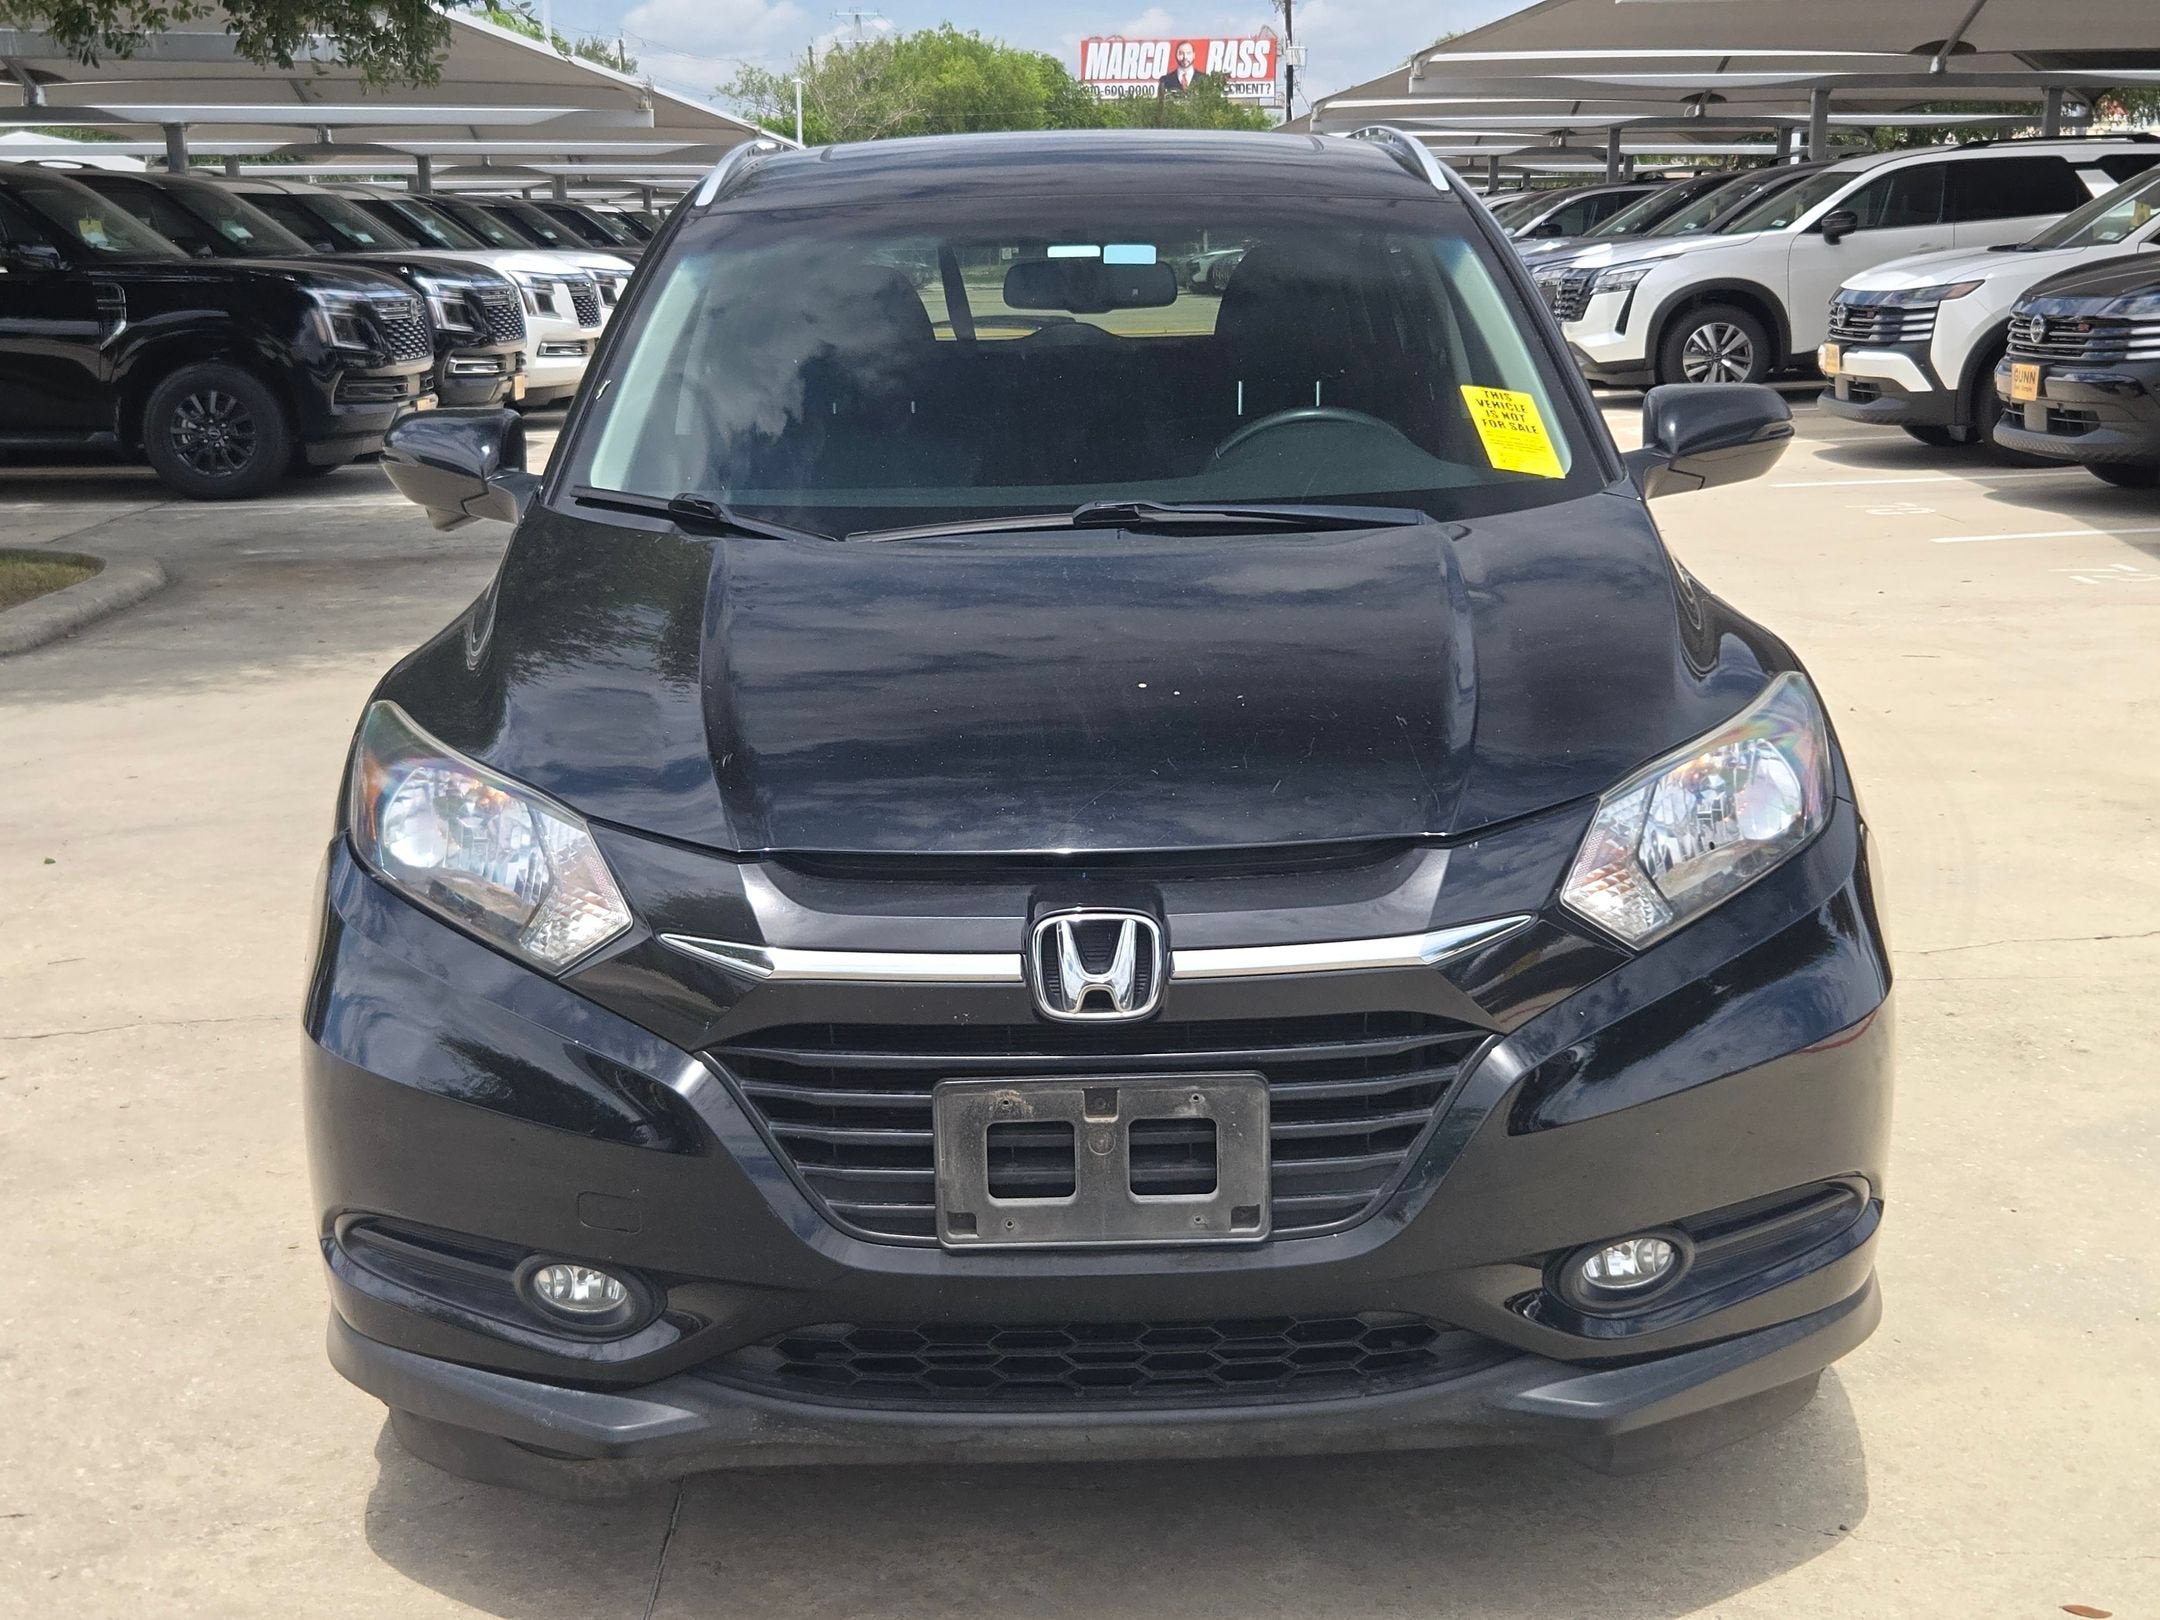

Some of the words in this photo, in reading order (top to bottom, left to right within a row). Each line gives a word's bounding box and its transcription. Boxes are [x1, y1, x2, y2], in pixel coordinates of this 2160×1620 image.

[1085, 41, 1171, 80] MARCO
[2014, 367, 2036, 385] GUNN
[1484, 390, 1512, 402] THIS
[1476, 399, 1528, 414] VEHICLE
[1486, 410, 1499, 419] IS
[1501, 411, 1526, 423] NOT
[1482, 419, 1506, 430] FOR
[1509, 422, 1538, 435] SALE
